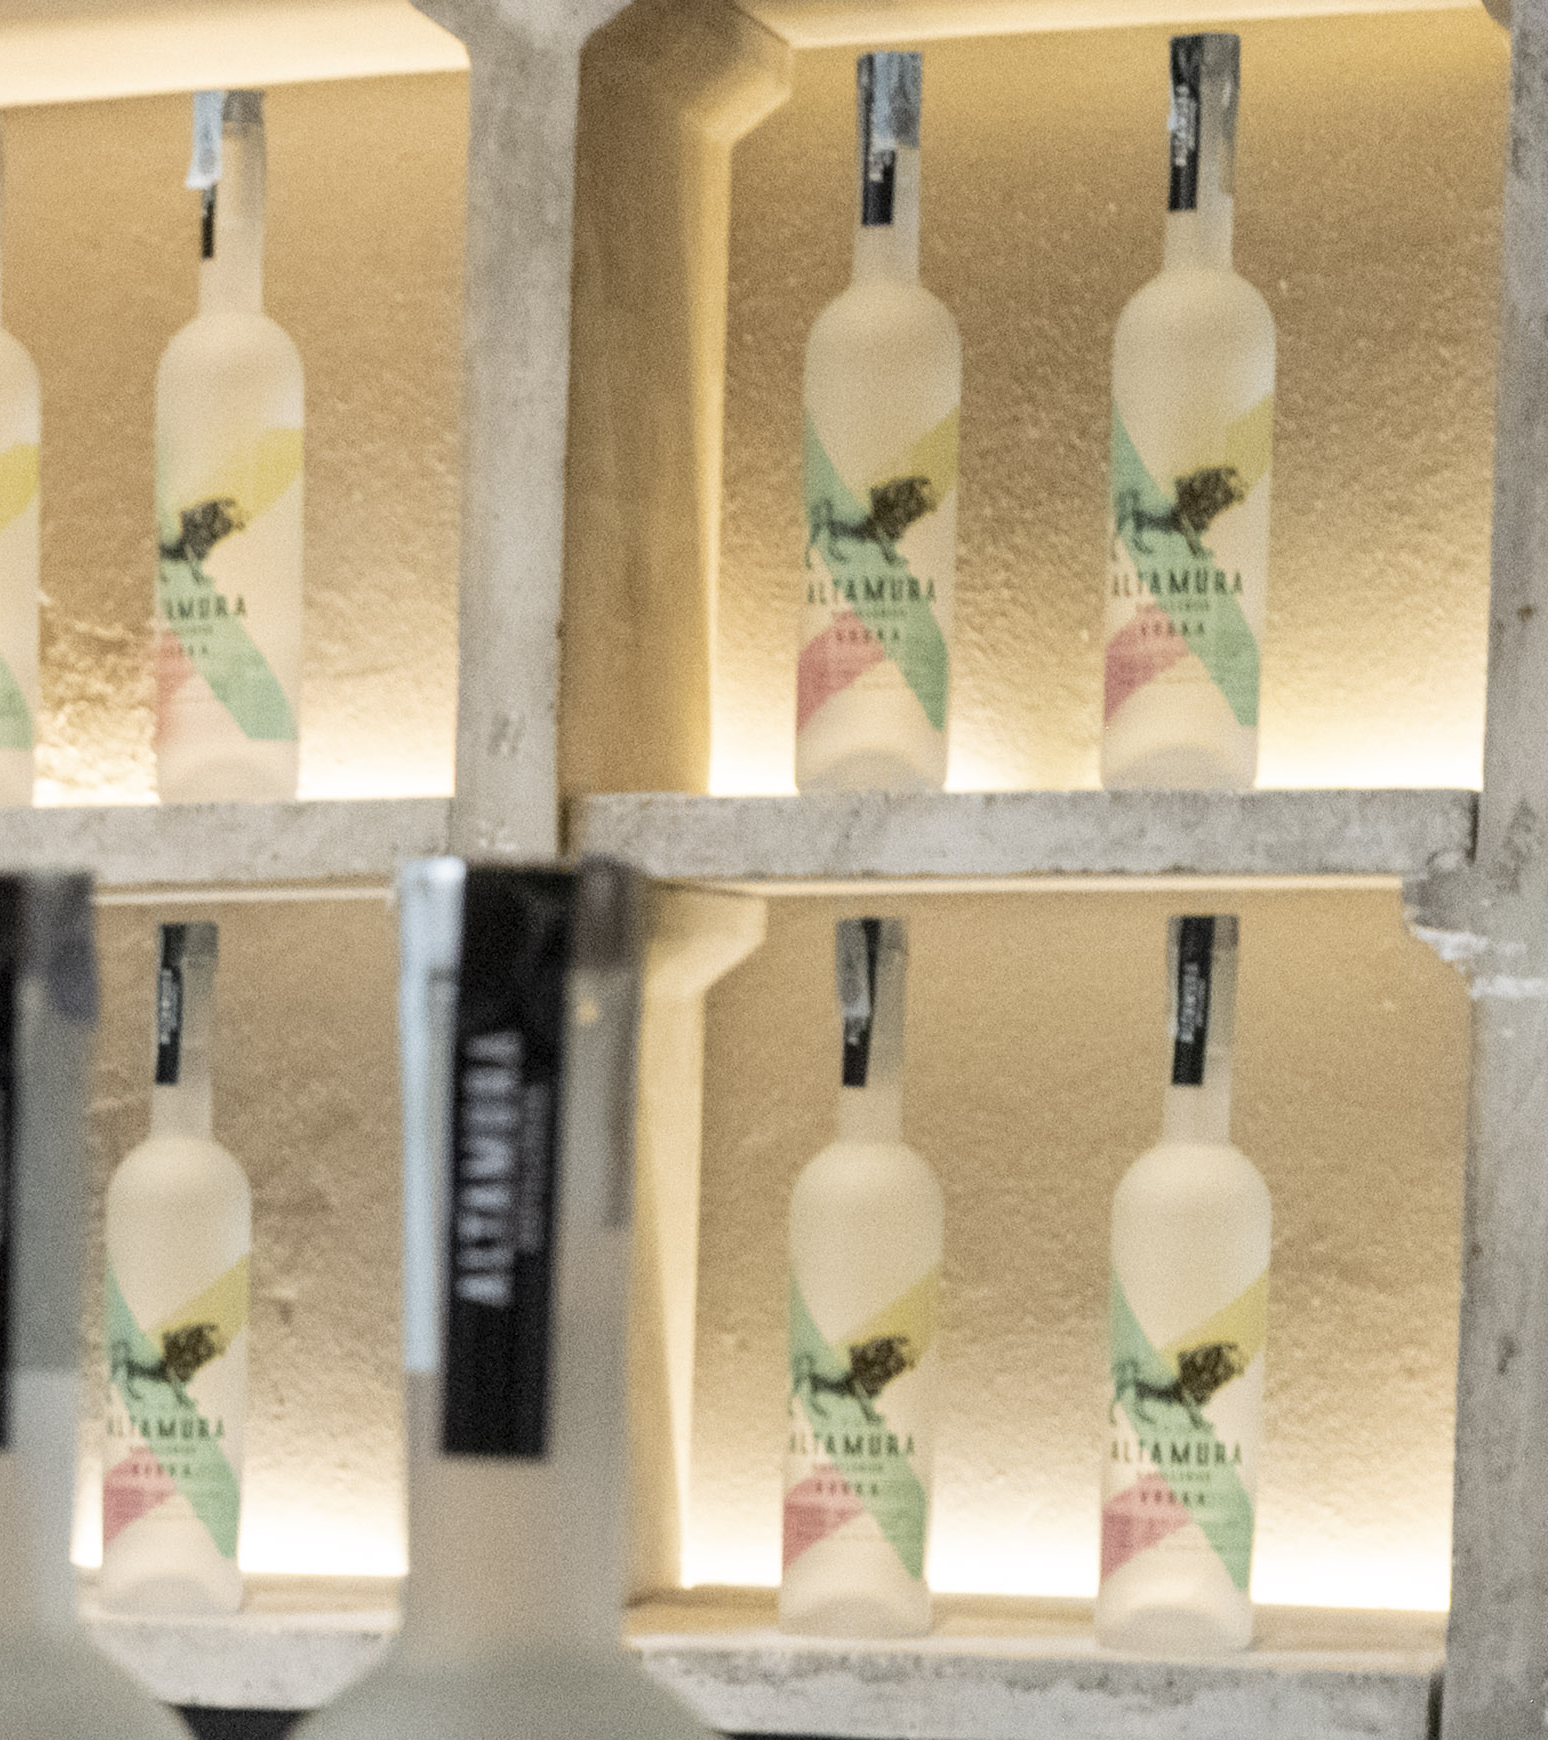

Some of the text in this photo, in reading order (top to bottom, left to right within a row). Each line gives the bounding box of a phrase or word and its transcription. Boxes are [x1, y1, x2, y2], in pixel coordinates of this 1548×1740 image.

[807, 577, 936, 606] ALTAMURA
[1110, 568, 1244, 600] ALTAMURA
[1110, 1439, 1242, 1467] ALTAMURA
